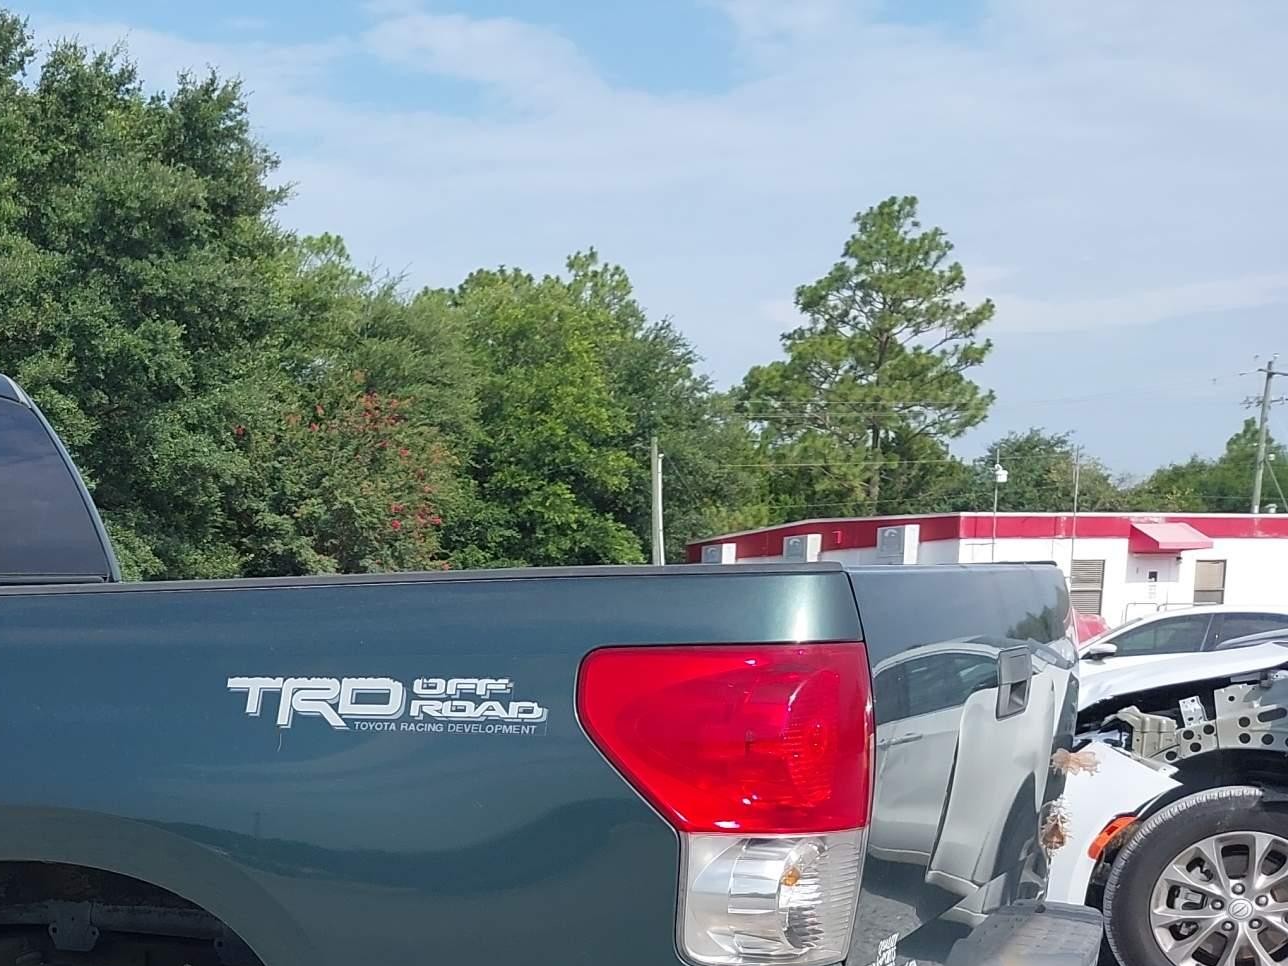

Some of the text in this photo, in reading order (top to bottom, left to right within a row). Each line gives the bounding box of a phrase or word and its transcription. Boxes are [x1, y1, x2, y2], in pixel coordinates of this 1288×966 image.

[412, 677, 514, 699] OFF
[226, 676, 408, 730] TRD
[409, 699, 549, 723] ROAD
[353, 720, 538, 735] TOYOTA RACING DEVELOPMENT
